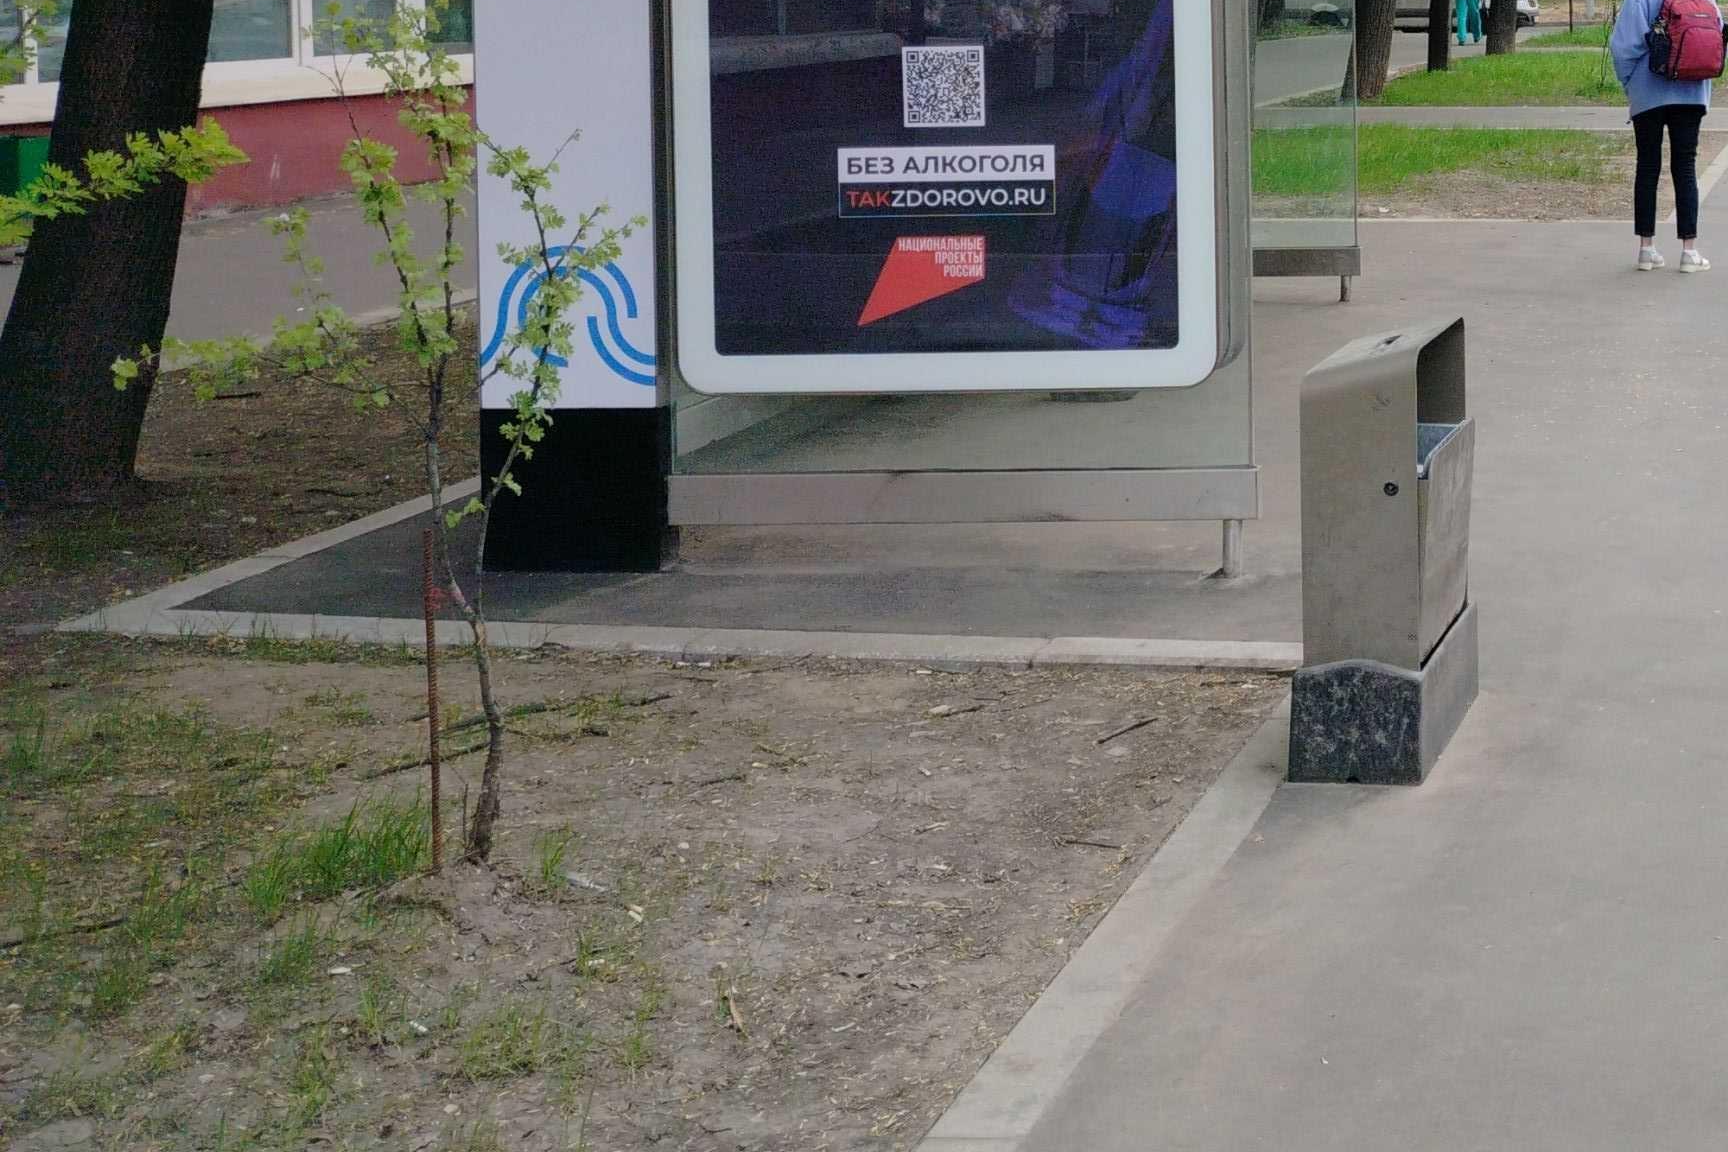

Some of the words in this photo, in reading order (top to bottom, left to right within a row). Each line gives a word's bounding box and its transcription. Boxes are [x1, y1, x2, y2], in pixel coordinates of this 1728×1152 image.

[846, 155, 895, 176] БЕЗ
[902, 153, 1045, 175] АЛКОГОЛЯ
[846, 187, 1046, 208] TAKZDOROVO.RU
[898, 236, 984, 252] НАЦИОНАЛЬНЫЕ
[935, 251, 984, 265] ПРОЕКТЫ
[943, 264, 984, 278] РОССИИ
